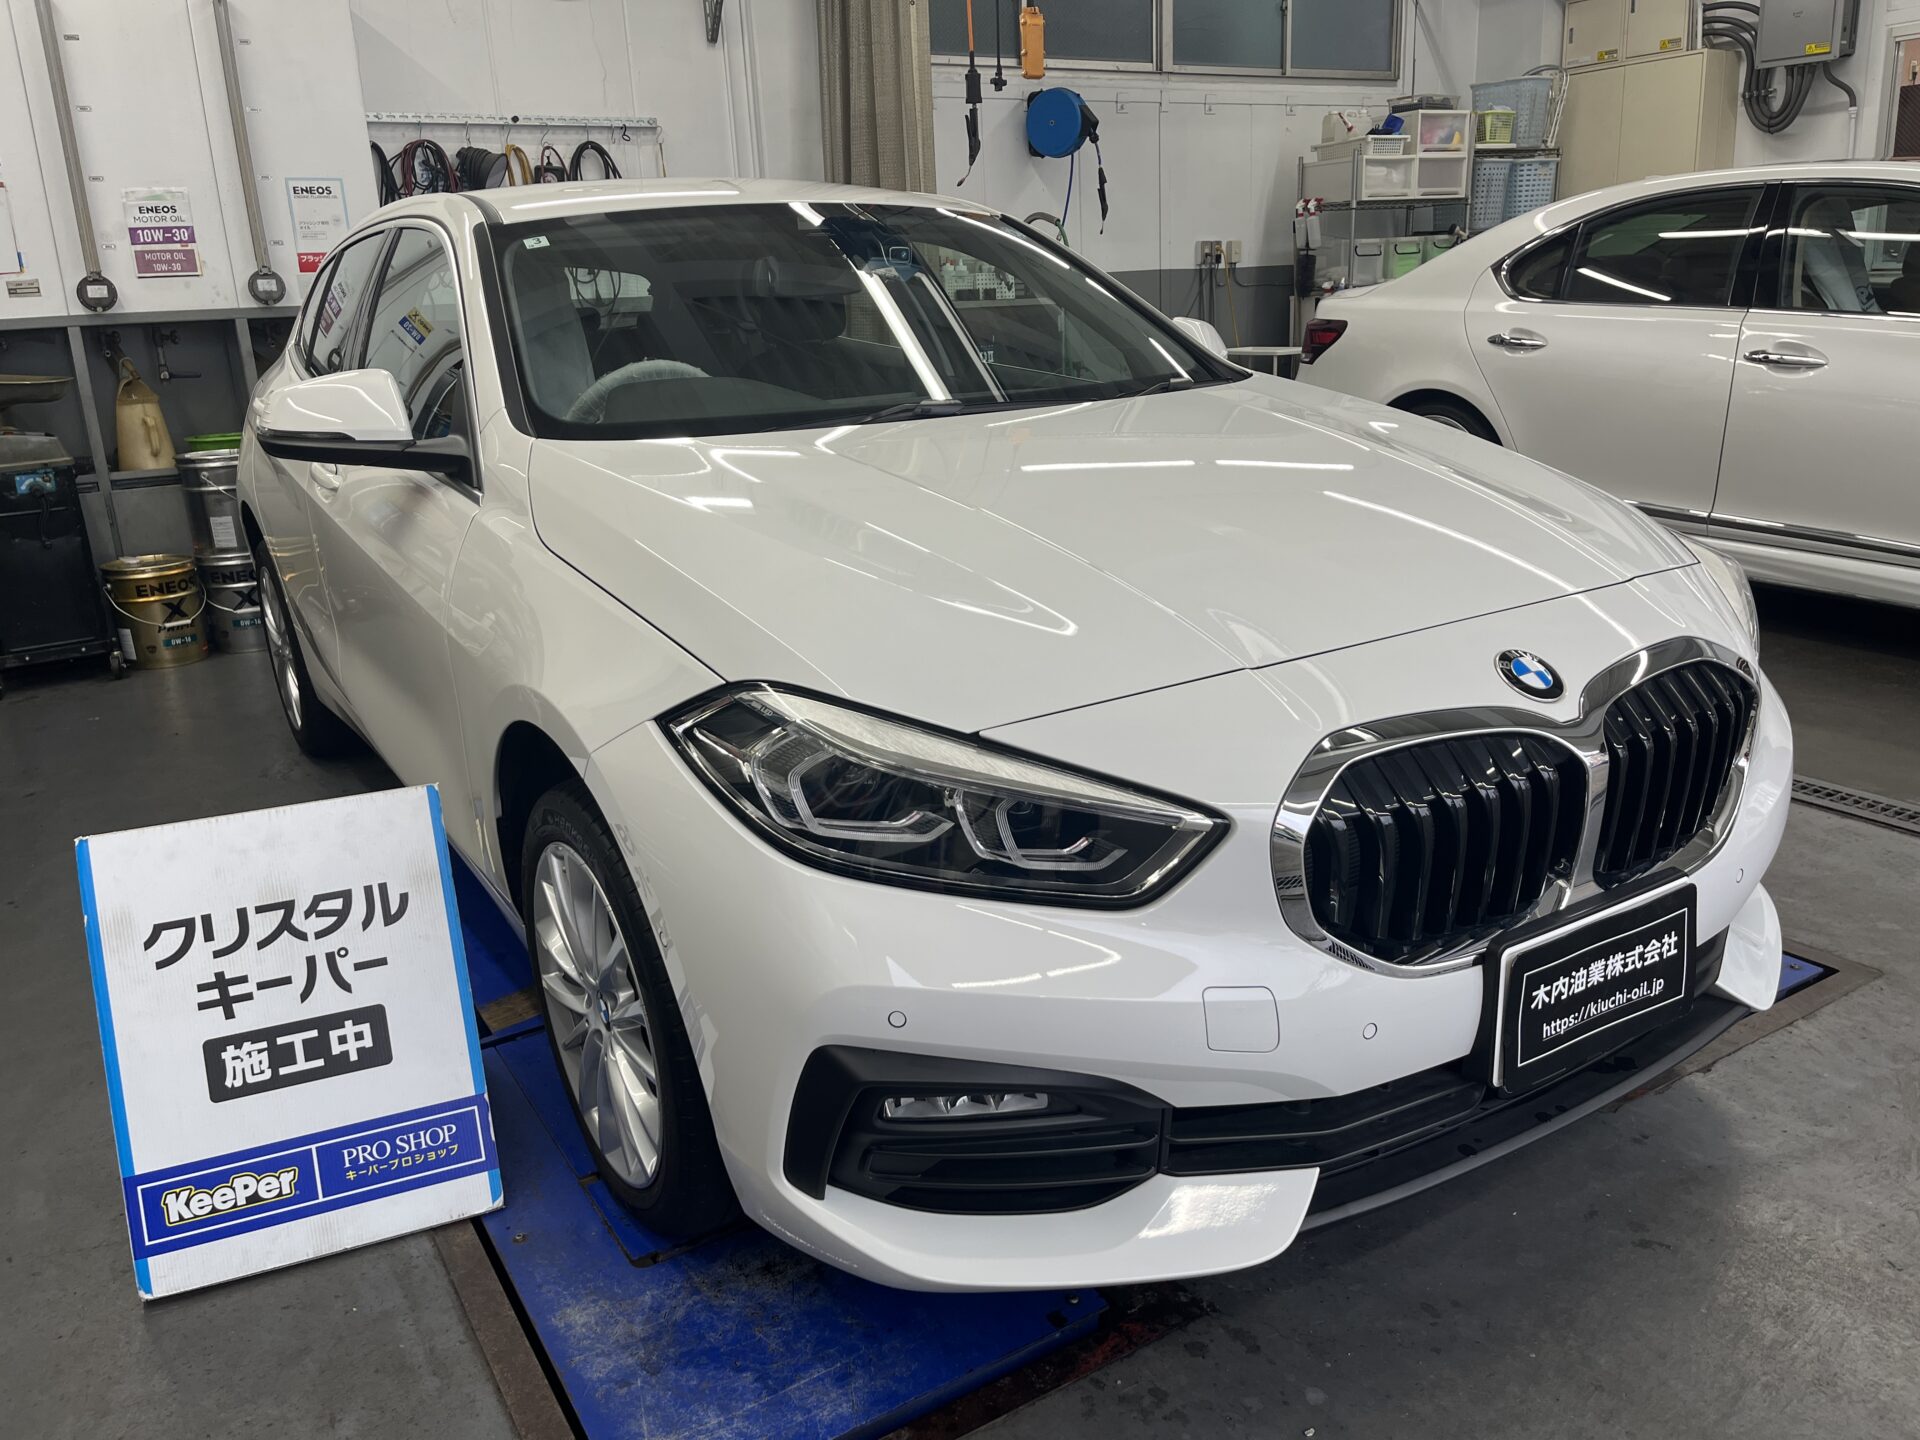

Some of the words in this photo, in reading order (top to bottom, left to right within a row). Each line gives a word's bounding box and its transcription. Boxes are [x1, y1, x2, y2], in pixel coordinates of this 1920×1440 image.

[293, 186, 332, 195] ENEOS
[133, 215, 167, 223] MOTOR
[138, 205, 177, 214] ENEOS
[137, 228, 188, 242] 10W-30
[145, 252, 172, 260] MOTOR
[174, 252, 186, 260] OIL
[153, 263, 181, 271] 10W-30
[135, 577, 197, 597] ENEOS
[171, 636, 192, 646] 0W-16
[143, 881, 409, 970] クリスタル
[196, 947, 388, 1020] キーパー
[1530, 931, 1678, 1010] 木内油業株式会社
[1542, 977, 1665, 1040] https://kiuchi-oil.jp
[221, 1020, 374, 1088] 施工中
[342, 1139, 391, 1168] PRO
[396, 1123, 457, 1155] SHOP
[345, 1144, 459, 1181] キーパープロショップ
[163, 1167, 298, 1225] KeePer
